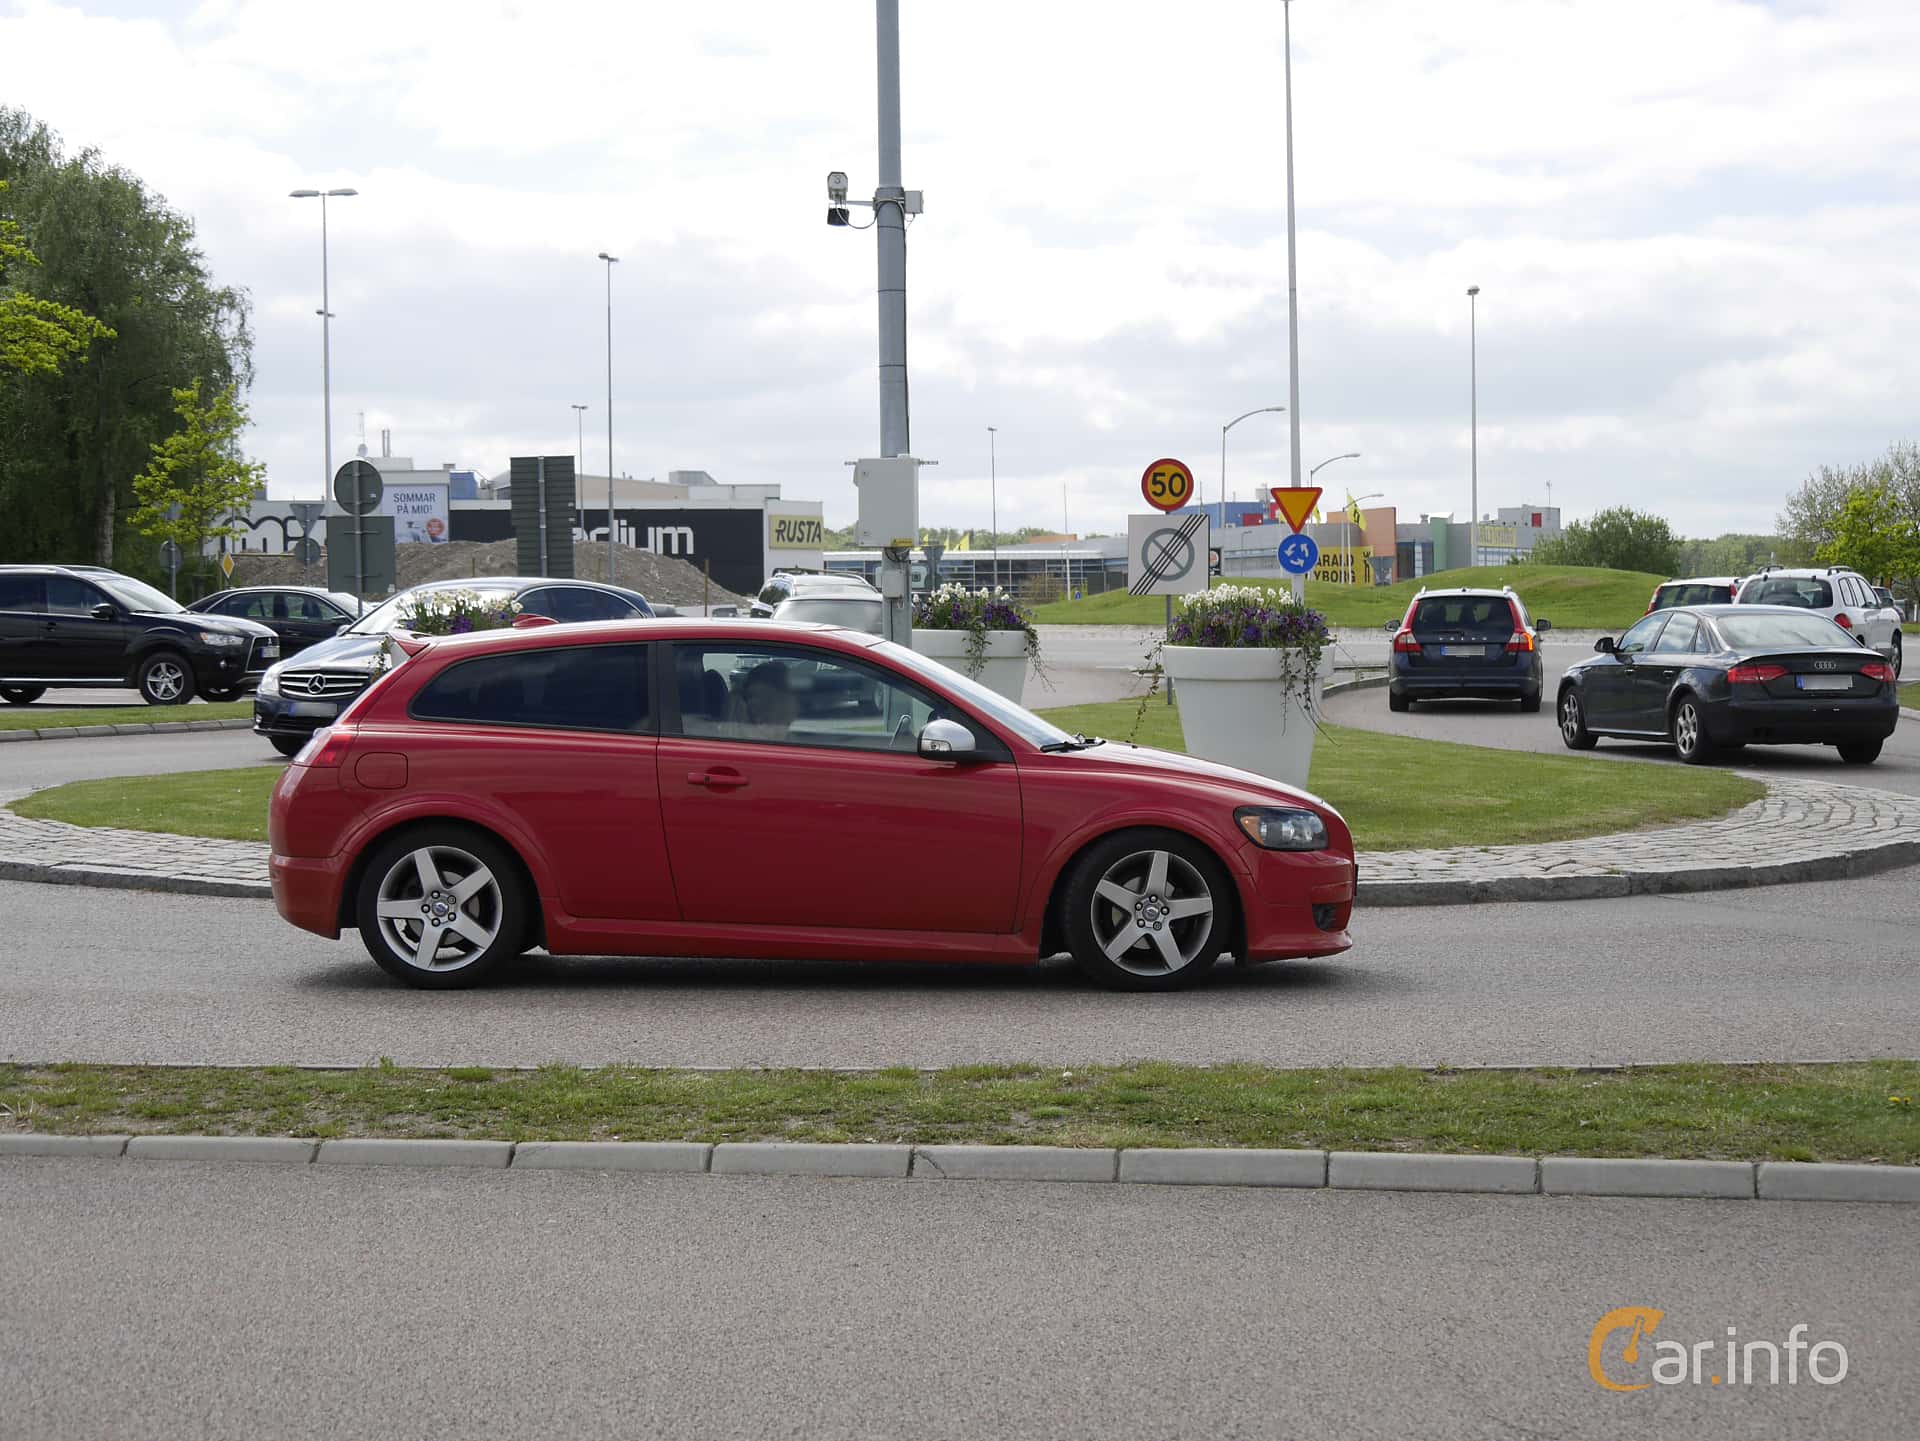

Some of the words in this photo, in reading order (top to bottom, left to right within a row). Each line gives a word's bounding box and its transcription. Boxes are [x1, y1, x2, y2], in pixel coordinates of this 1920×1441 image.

[1151, 472, 1186, 497] 50
[393, 493, 436, 503] SOMMAR
[775, 520, 822, 543] RUSTA
